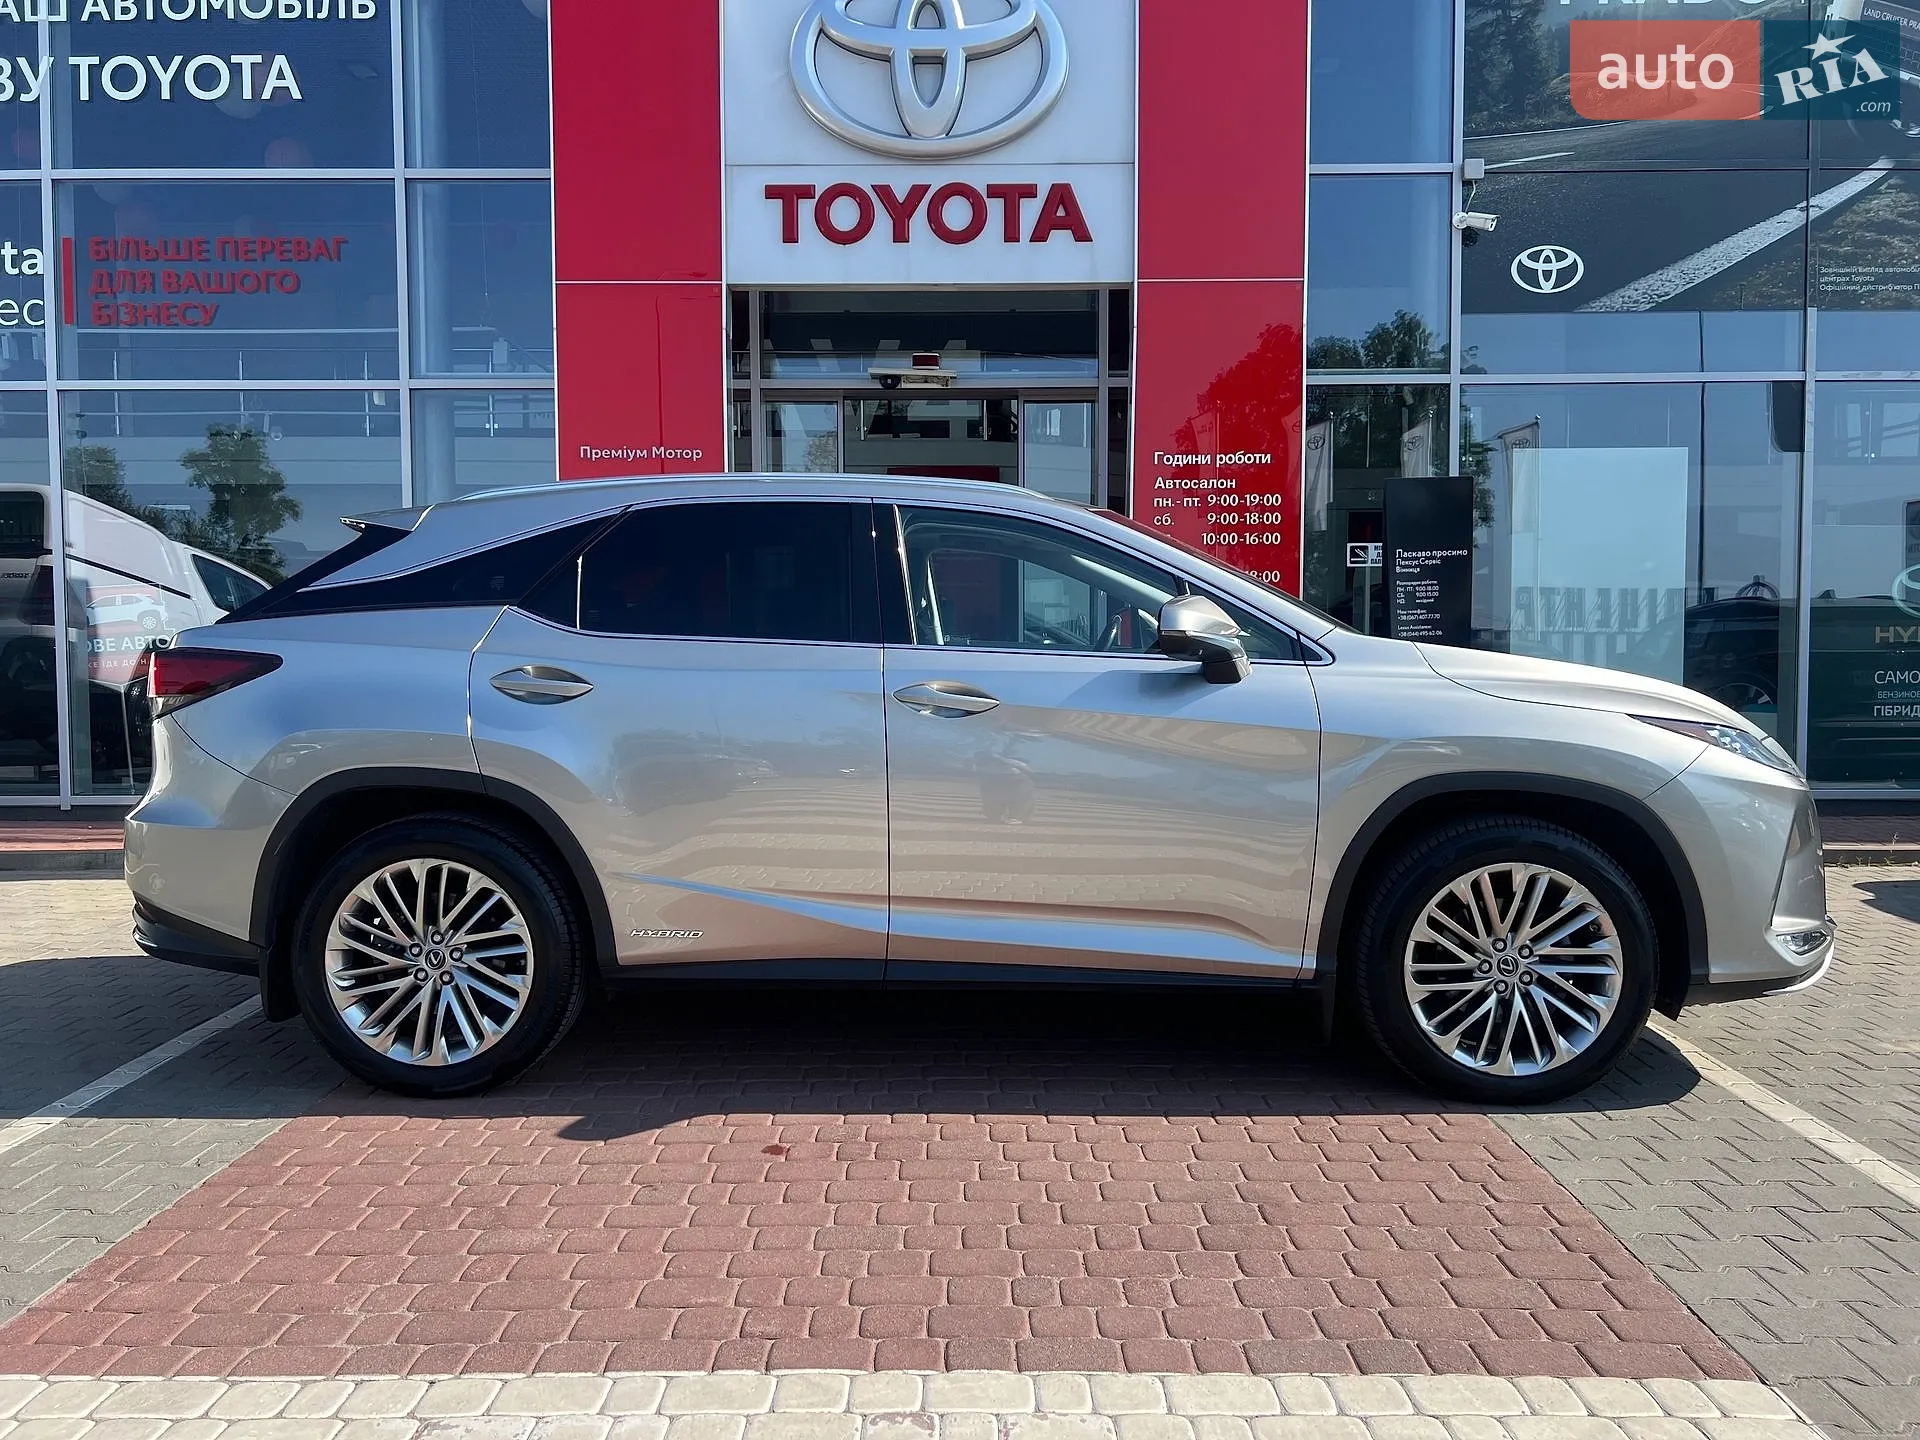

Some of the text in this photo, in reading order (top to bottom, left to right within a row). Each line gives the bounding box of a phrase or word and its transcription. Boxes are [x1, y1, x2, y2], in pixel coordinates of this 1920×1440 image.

[81, 0, 376, 21] АВТОМОБІЛЬ
[68, 55, 303, 101] TOYOTA
[764, 181, 1094, 245] TOYOTA
[89, 236, 348, 262] БІЛЬШЕ ПЕРЕВАГ
[89, 268, 300, 297] ДЛЯ ВАШОГО
[91, 302, 218, 326] БІЗНЕСУ
[580, 445, 703, 461] Преміум Мотор
[1154, 450, 1271, 468] Години роботи
[1153, 477, 1236, 489] Автосалон
[1207, 493, 1282, 507] 9:00-19:00
[1153, 512, 1282, 526] сб. 9:00-18:00
[1201, 532, 1281, 545] 10:00-16:00
[1396, 549, 1468, 559] Ласкаво просимо
[1396, 558, 1442, 567] Лексус Сервіс
[1875, 626, 1920, 643] HY
[121, 634, 171, 652] АВТО
[1874, 670, 1920, 684] САМО
[1873, 704, 1920, 717] ГІБРИД
[630, 929, 704, 938] HYBRID
